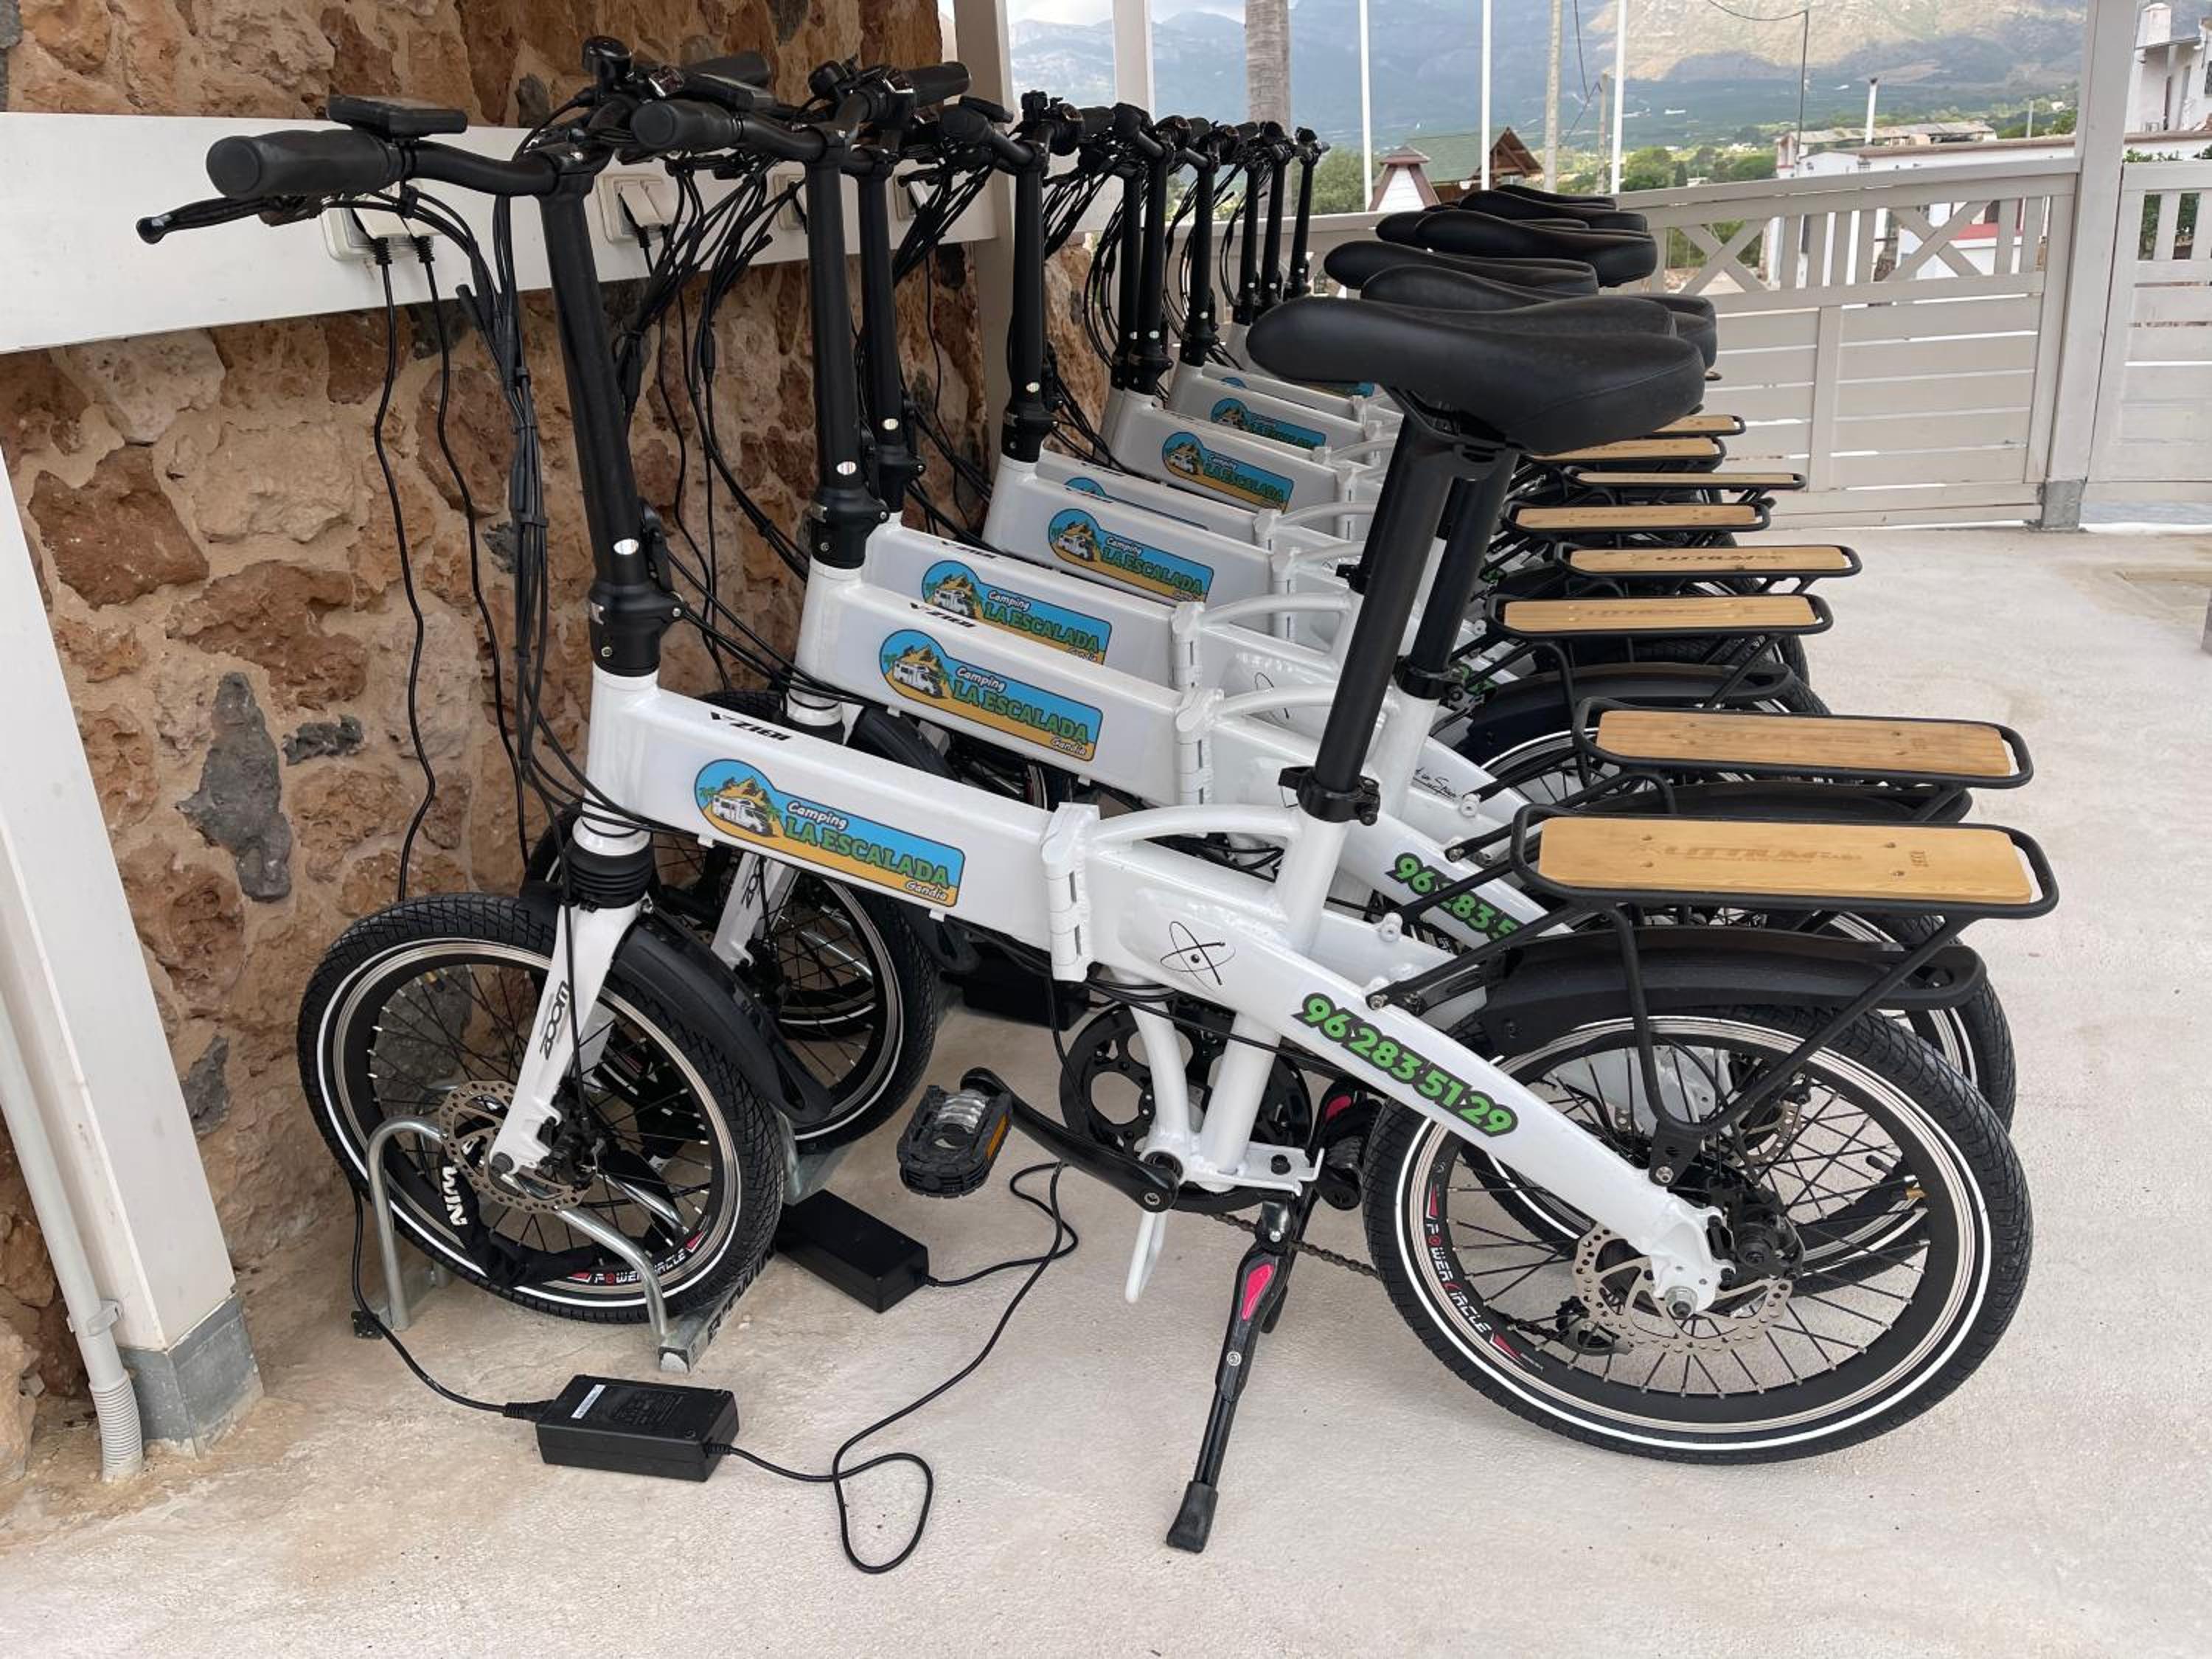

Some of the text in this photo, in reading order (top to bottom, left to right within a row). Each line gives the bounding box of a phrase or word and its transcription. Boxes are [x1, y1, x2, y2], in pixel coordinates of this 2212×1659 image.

[988, 591, 1031, 612] Camping
[984, 602, 1099, 654] LA ESCALADA
[956, 667, 1006, 693] Camping
[954, 680, 1088, 744] LA ESCALADA
[1050, 737, 1086, 756] Gandia
[787, 801, 848, 830] Camping
[785, 815, 949, 888] LA ESCALADA
[905, 880, 948, 902] Gandia
[1302, 993, 1516, 1135] 96 283 51 29
